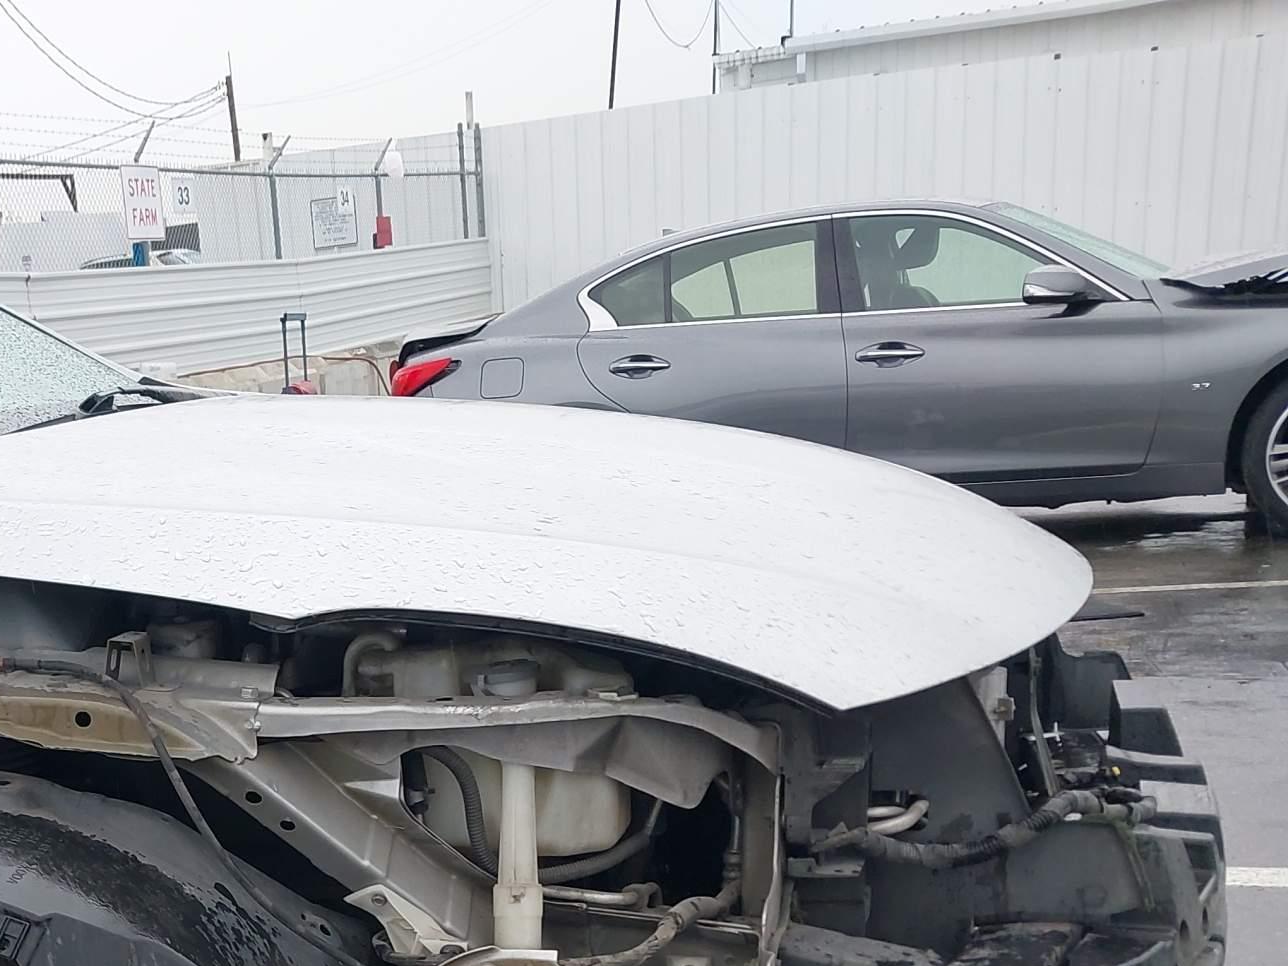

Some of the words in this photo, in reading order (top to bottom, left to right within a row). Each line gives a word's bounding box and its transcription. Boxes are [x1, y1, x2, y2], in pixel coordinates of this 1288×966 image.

[128, 178, 157, 197] STATE
[177, 186, 190, 205] 33
[340, 189, 349, 206] 34
[132, 208, 158, 226] FARM
